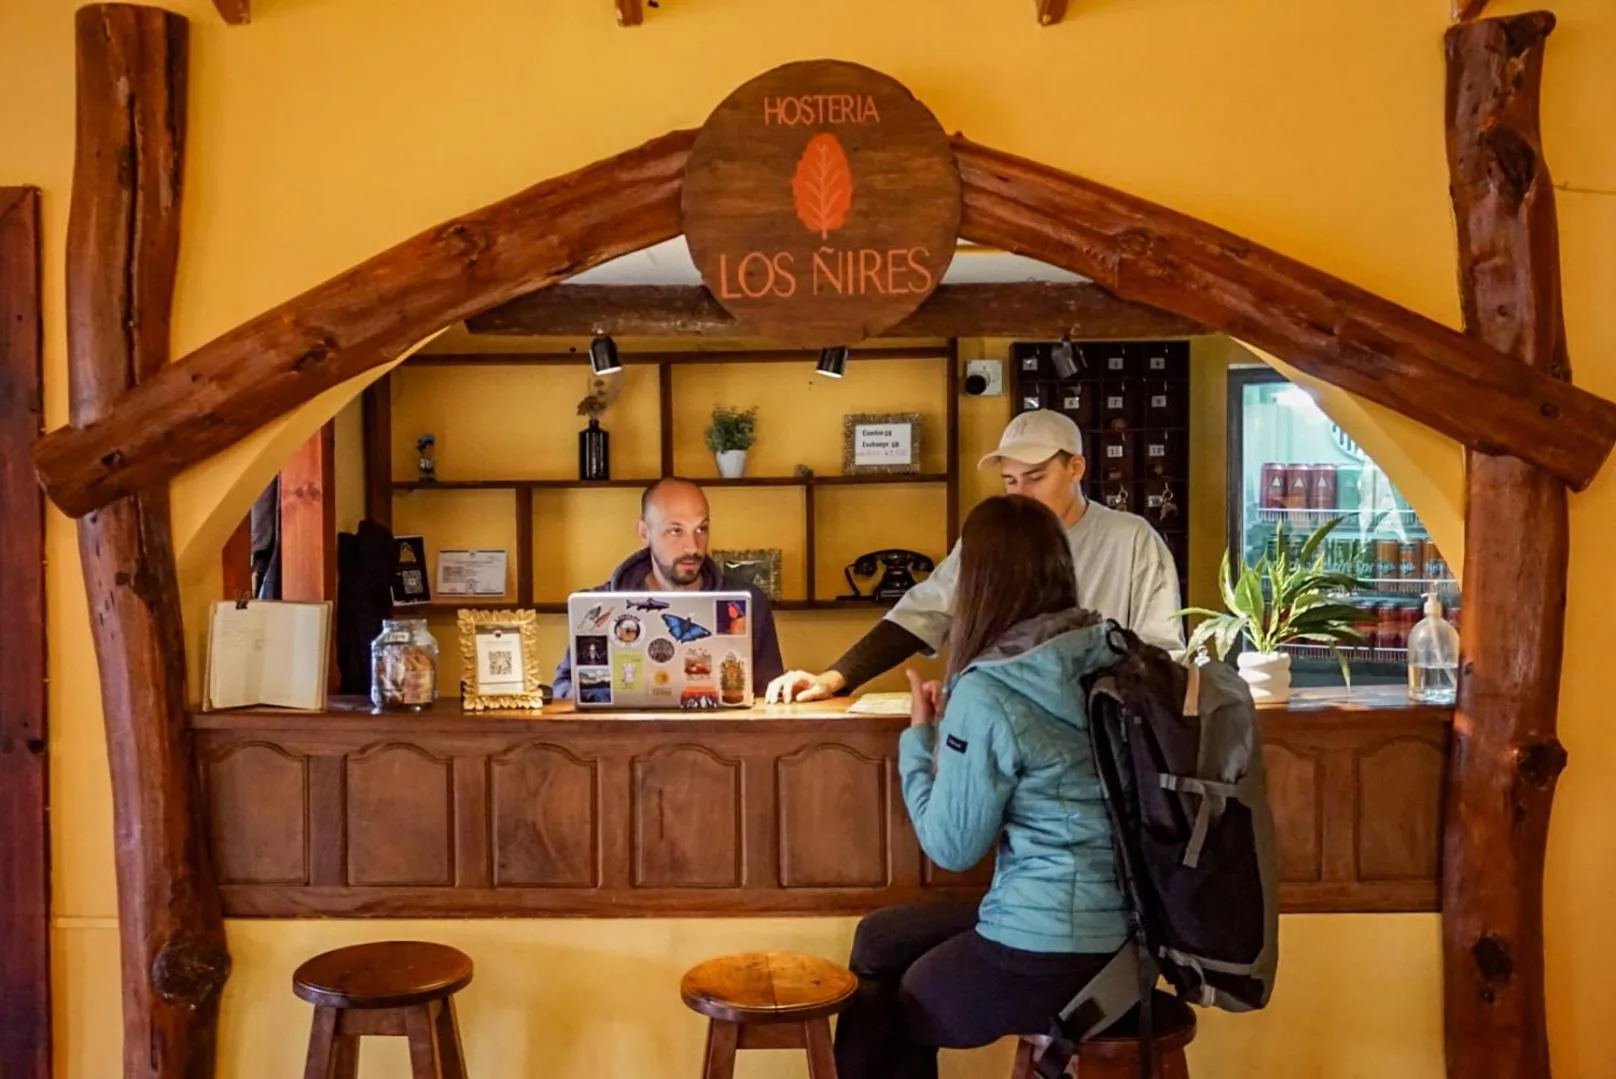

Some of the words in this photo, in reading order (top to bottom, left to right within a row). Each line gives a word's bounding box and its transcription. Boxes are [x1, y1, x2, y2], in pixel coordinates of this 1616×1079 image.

[763, 95, 880, 126] HOSTERIA
[719, 251, 797, 299] LOS
[812, 246, 932, 296] ÑIRES
